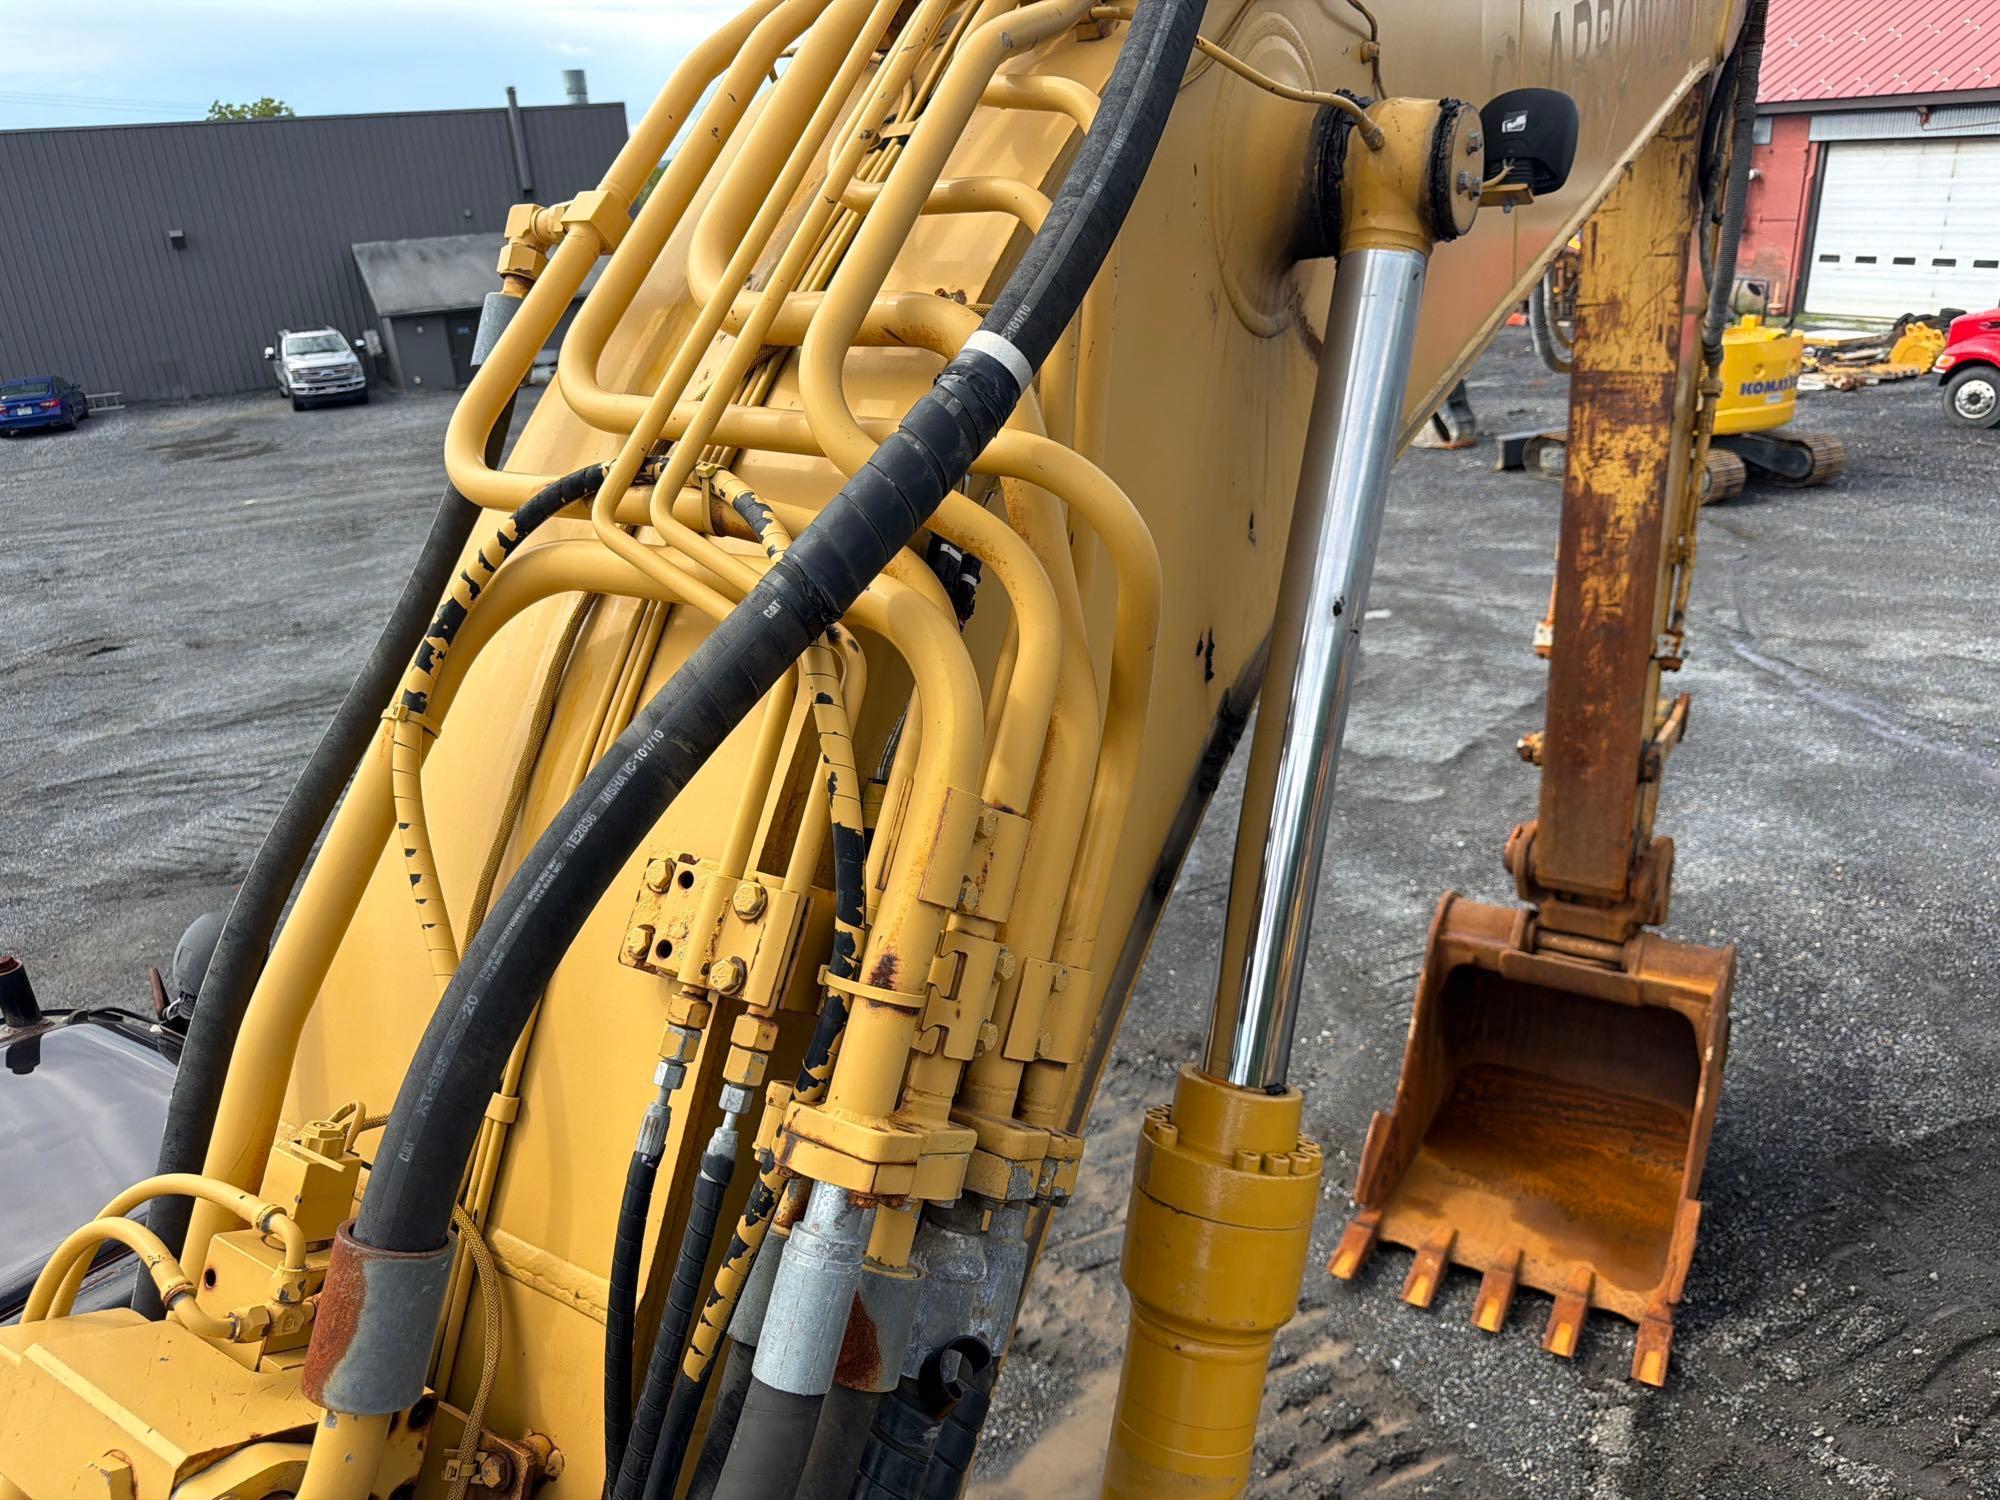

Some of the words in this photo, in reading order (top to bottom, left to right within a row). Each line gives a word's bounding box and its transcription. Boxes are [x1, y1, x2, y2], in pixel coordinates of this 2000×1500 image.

[1740, 376, 1796, 395] KOMAT
[763, 600, 781, 619] CAT
[566, 812, 597, 850] 1E2836
[600, 775, 628, 804] MSHA
[625, 729, 664, 774] IC-101/10
[398, 1143, 415, 1162] CAT
[416, 1055, 449, 1117] XT-6ES
[462, 995, 478, 1019] -20
